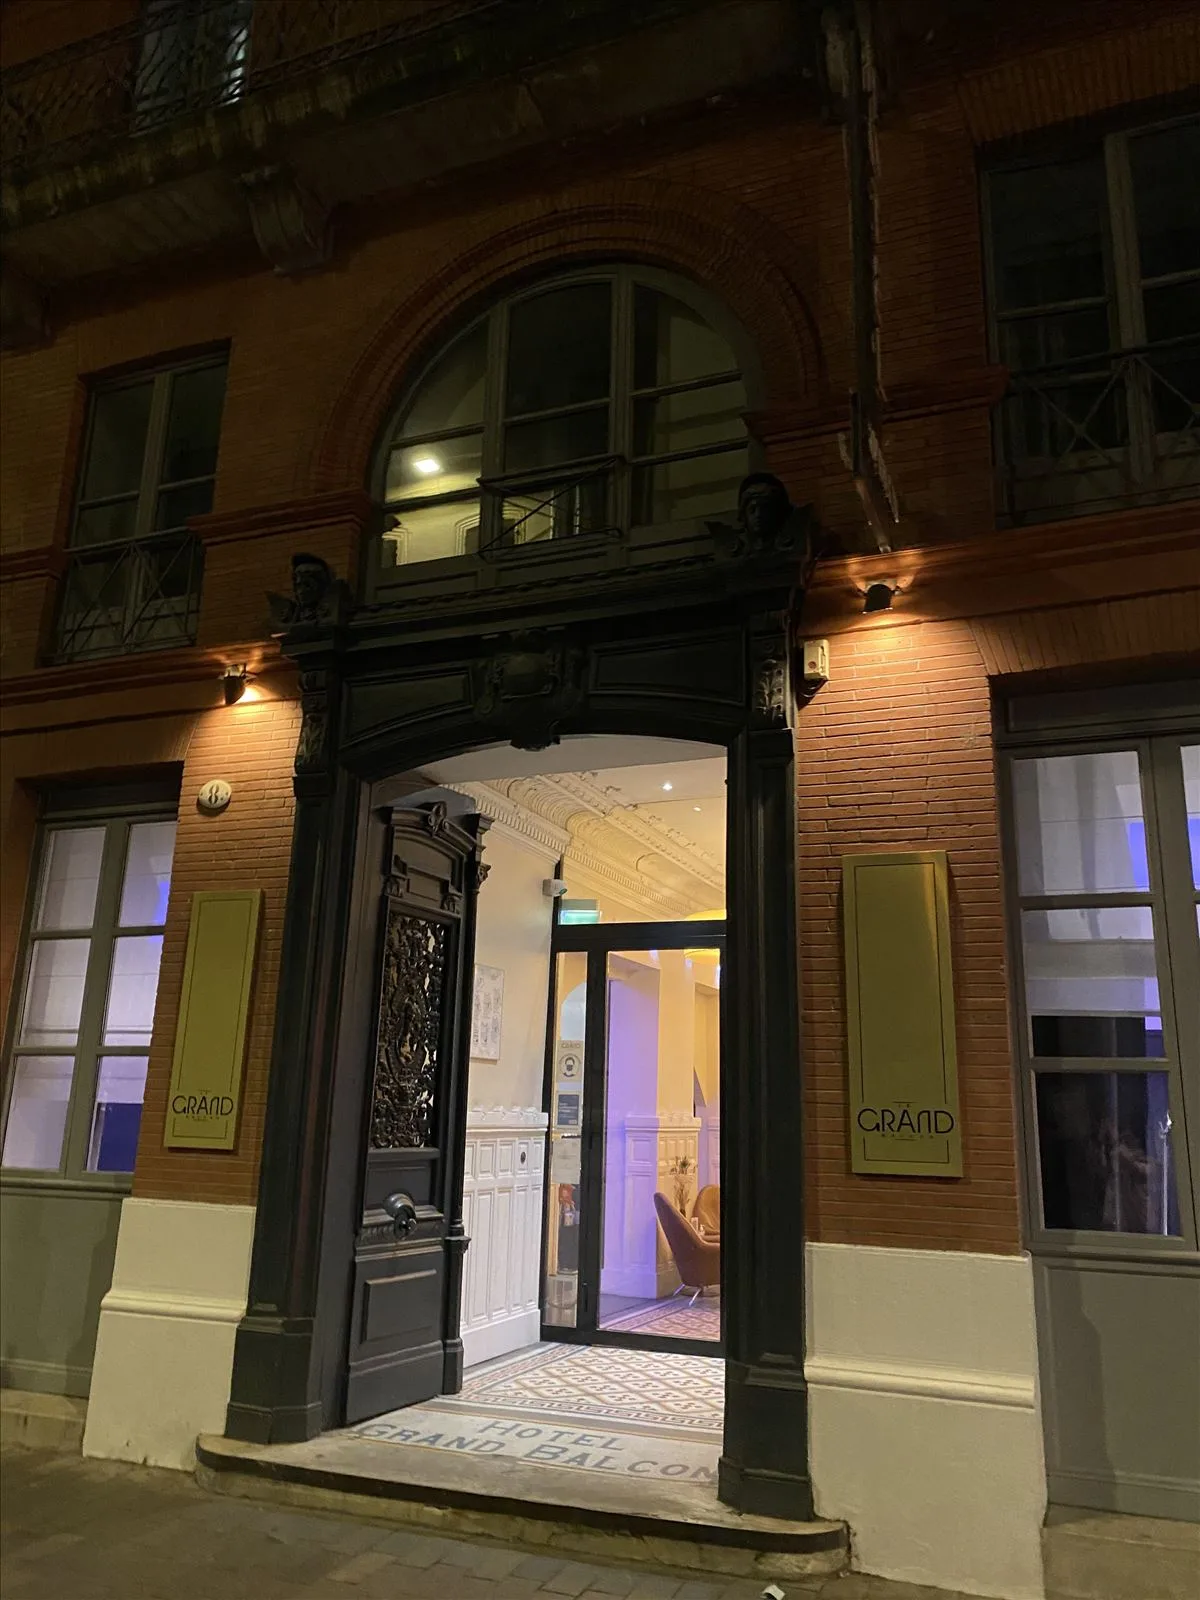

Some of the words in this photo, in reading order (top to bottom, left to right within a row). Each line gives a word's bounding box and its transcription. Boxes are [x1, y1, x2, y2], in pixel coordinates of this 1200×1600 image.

[172, 1095, 234, 1116] GRAND
[858, 1108, 954, 1134] GRAND
[359, 1423, 505, 1453] GRAND
[477, 1420, 627, 1451] HOTEL
